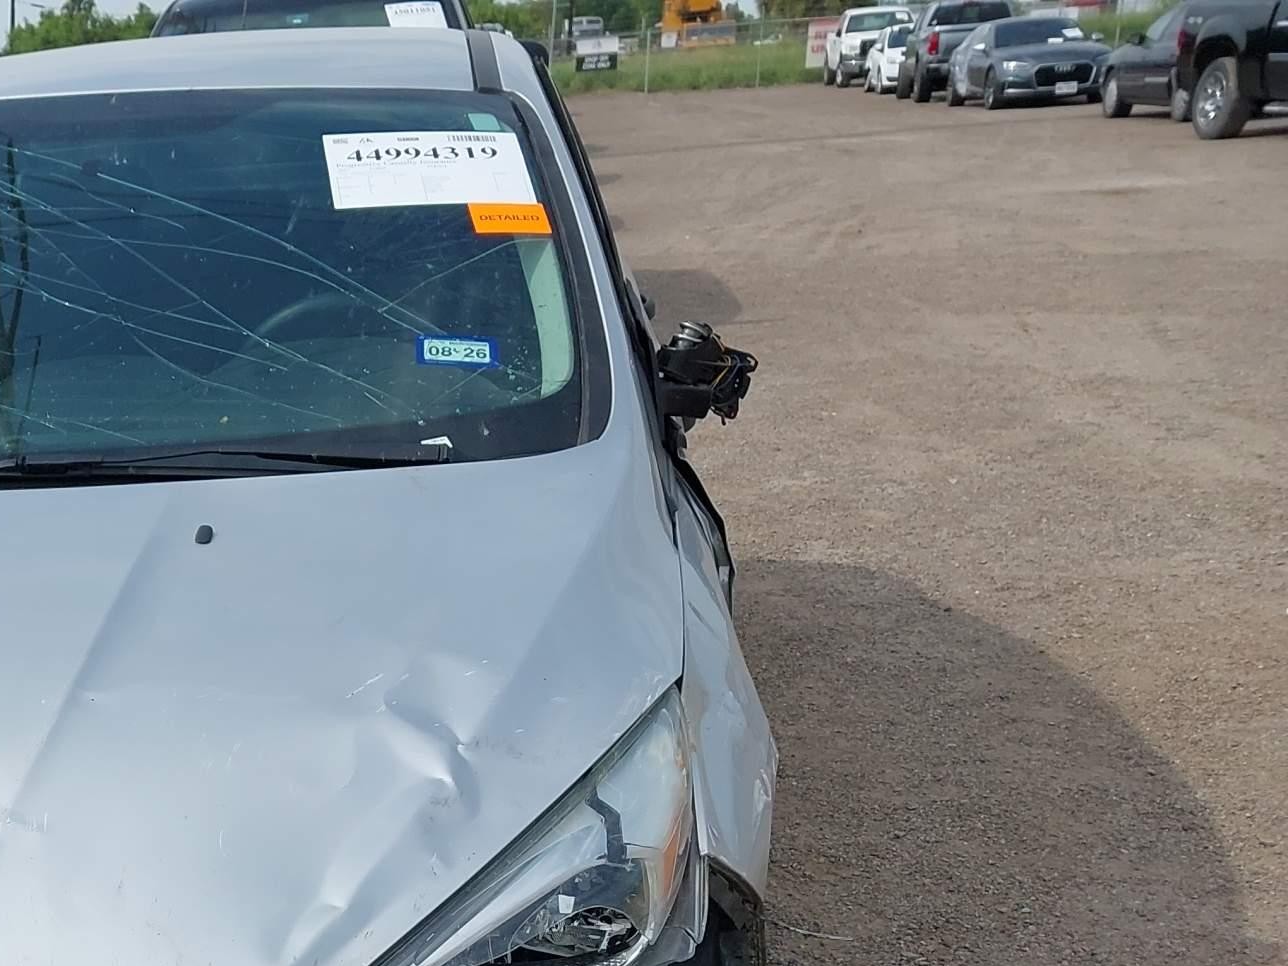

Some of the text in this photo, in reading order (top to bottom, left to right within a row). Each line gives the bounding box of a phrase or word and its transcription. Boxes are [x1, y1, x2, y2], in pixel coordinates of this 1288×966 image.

[346, 146, 499, 162] 44994319
[479, 214, 540, 222] DETAILED
[428, 345, 487, 359] 08 26
